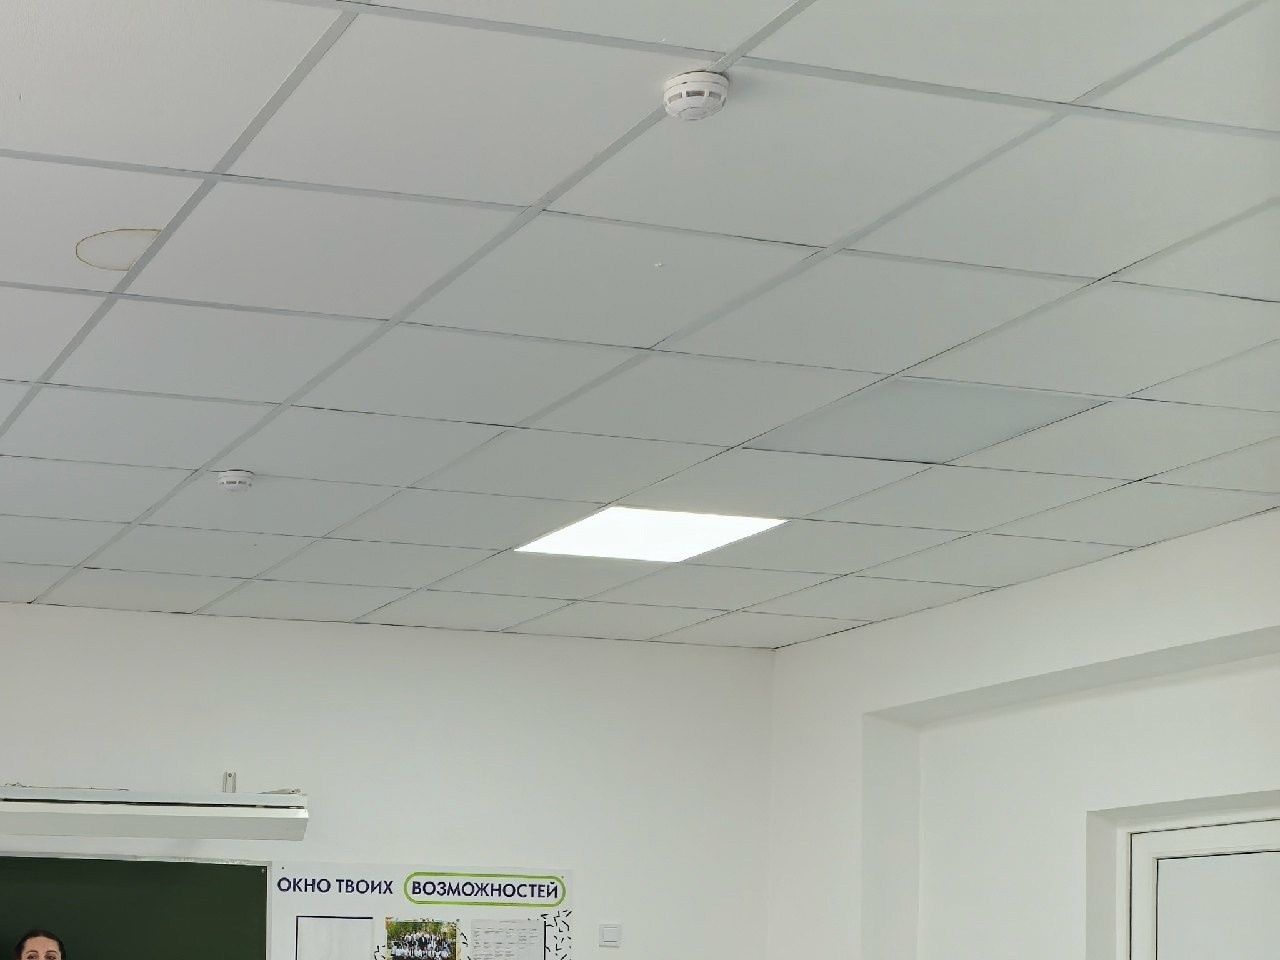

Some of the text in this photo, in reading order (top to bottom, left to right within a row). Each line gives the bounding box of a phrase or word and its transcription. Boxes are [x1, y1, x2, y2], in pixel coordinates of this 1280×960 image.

[277, 877, 558, 899] ОКНО ТВОИХ ВОЗМОЖНОСТЕЙ
